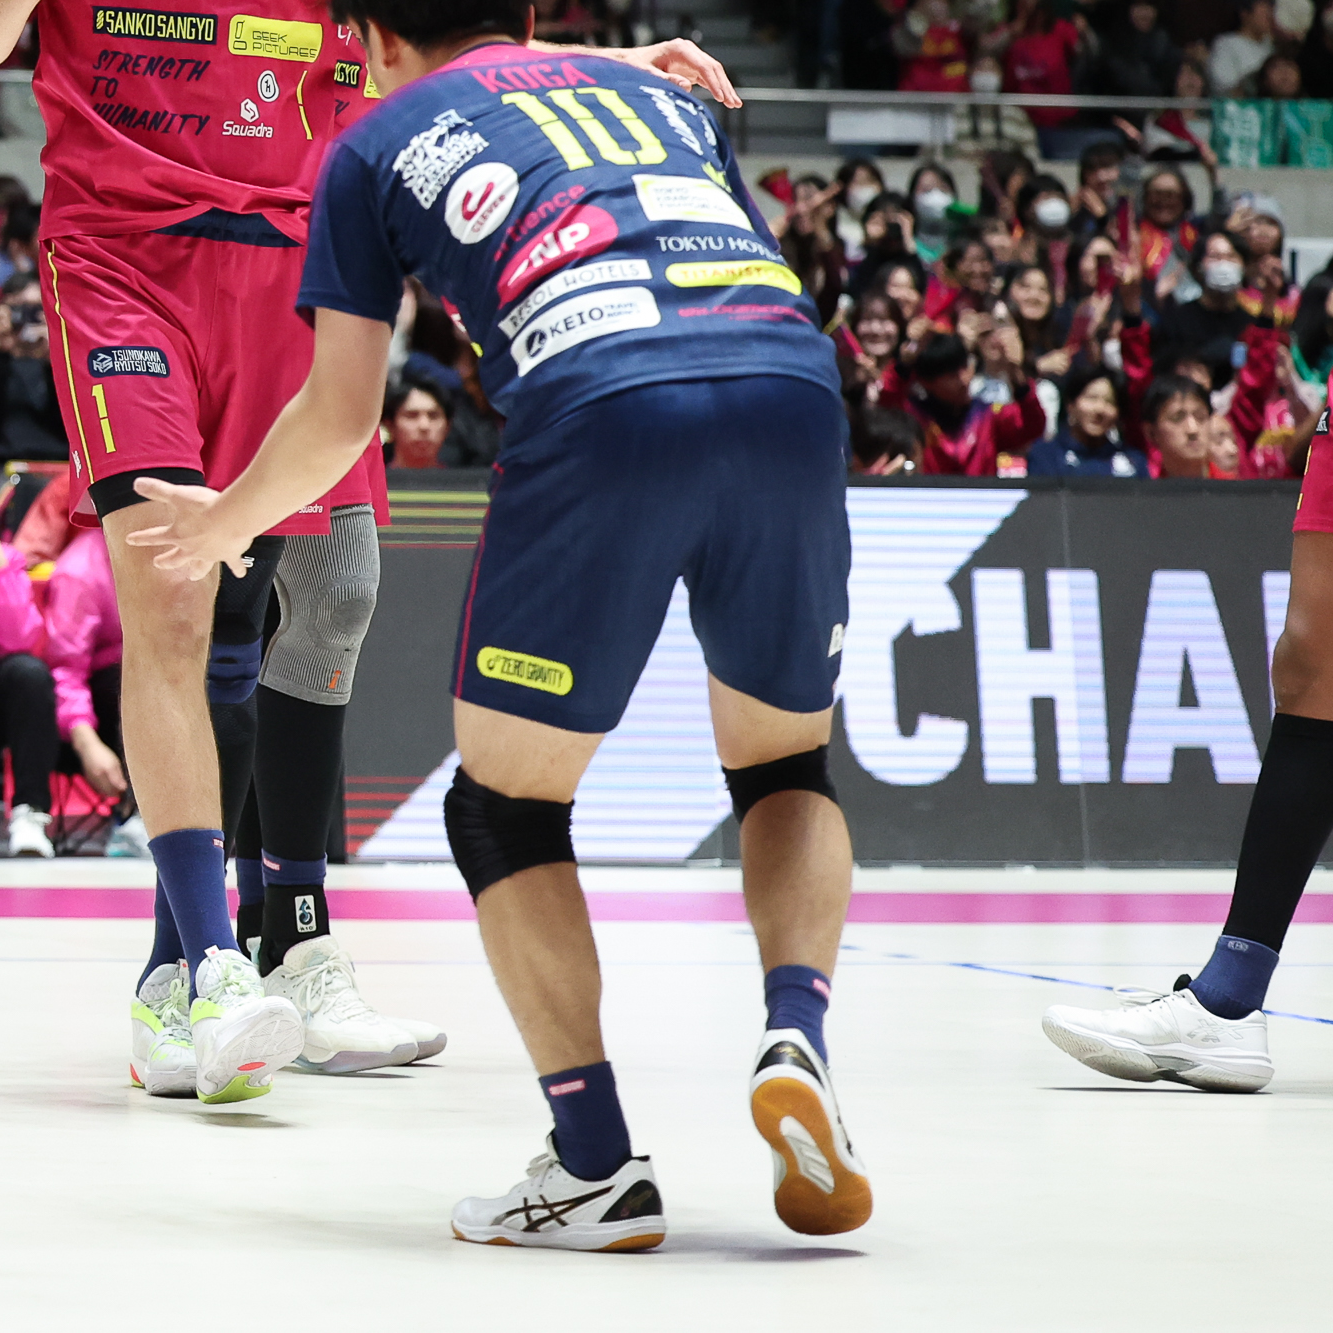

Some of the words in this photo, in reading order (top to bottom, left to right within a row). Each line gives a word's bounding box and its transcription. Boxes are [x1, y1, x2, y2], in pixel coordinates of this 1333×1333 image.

[105, 10, 155, 37] SANKO
[157, 14, 215, 42] SANGYO
[252, 30, 288, 44] GEEK
[93, 49, 211, 81] STRENGTH
[253, 42, 318, 58] PICTURES
[90, 76, 119, 98] TO
[334, 62, 360, 84] GYO
[471, 62, 597, 93] KOGA
[91, 103, 210, 136] HUMANITY
[222, 121, 274, 138] Squadra
[501, 86, 668, 171] 10
[656, 235, 724, 252] TOKYU
[730, 236, 785, 259] HOT
[510, 284, 554, 328] RESOL
[563, 263, 640, 288] HOTELS
[550, 306, 604, 338] KEIO
[111, 349, 162, 364] TSUNOKAWA
[113, 360, 147, 373] RYUTSU
[147, 360, 167, 375] SOKO
[91, 384, 117, 454] 1
[844, 566, 1290, 788] CHA
